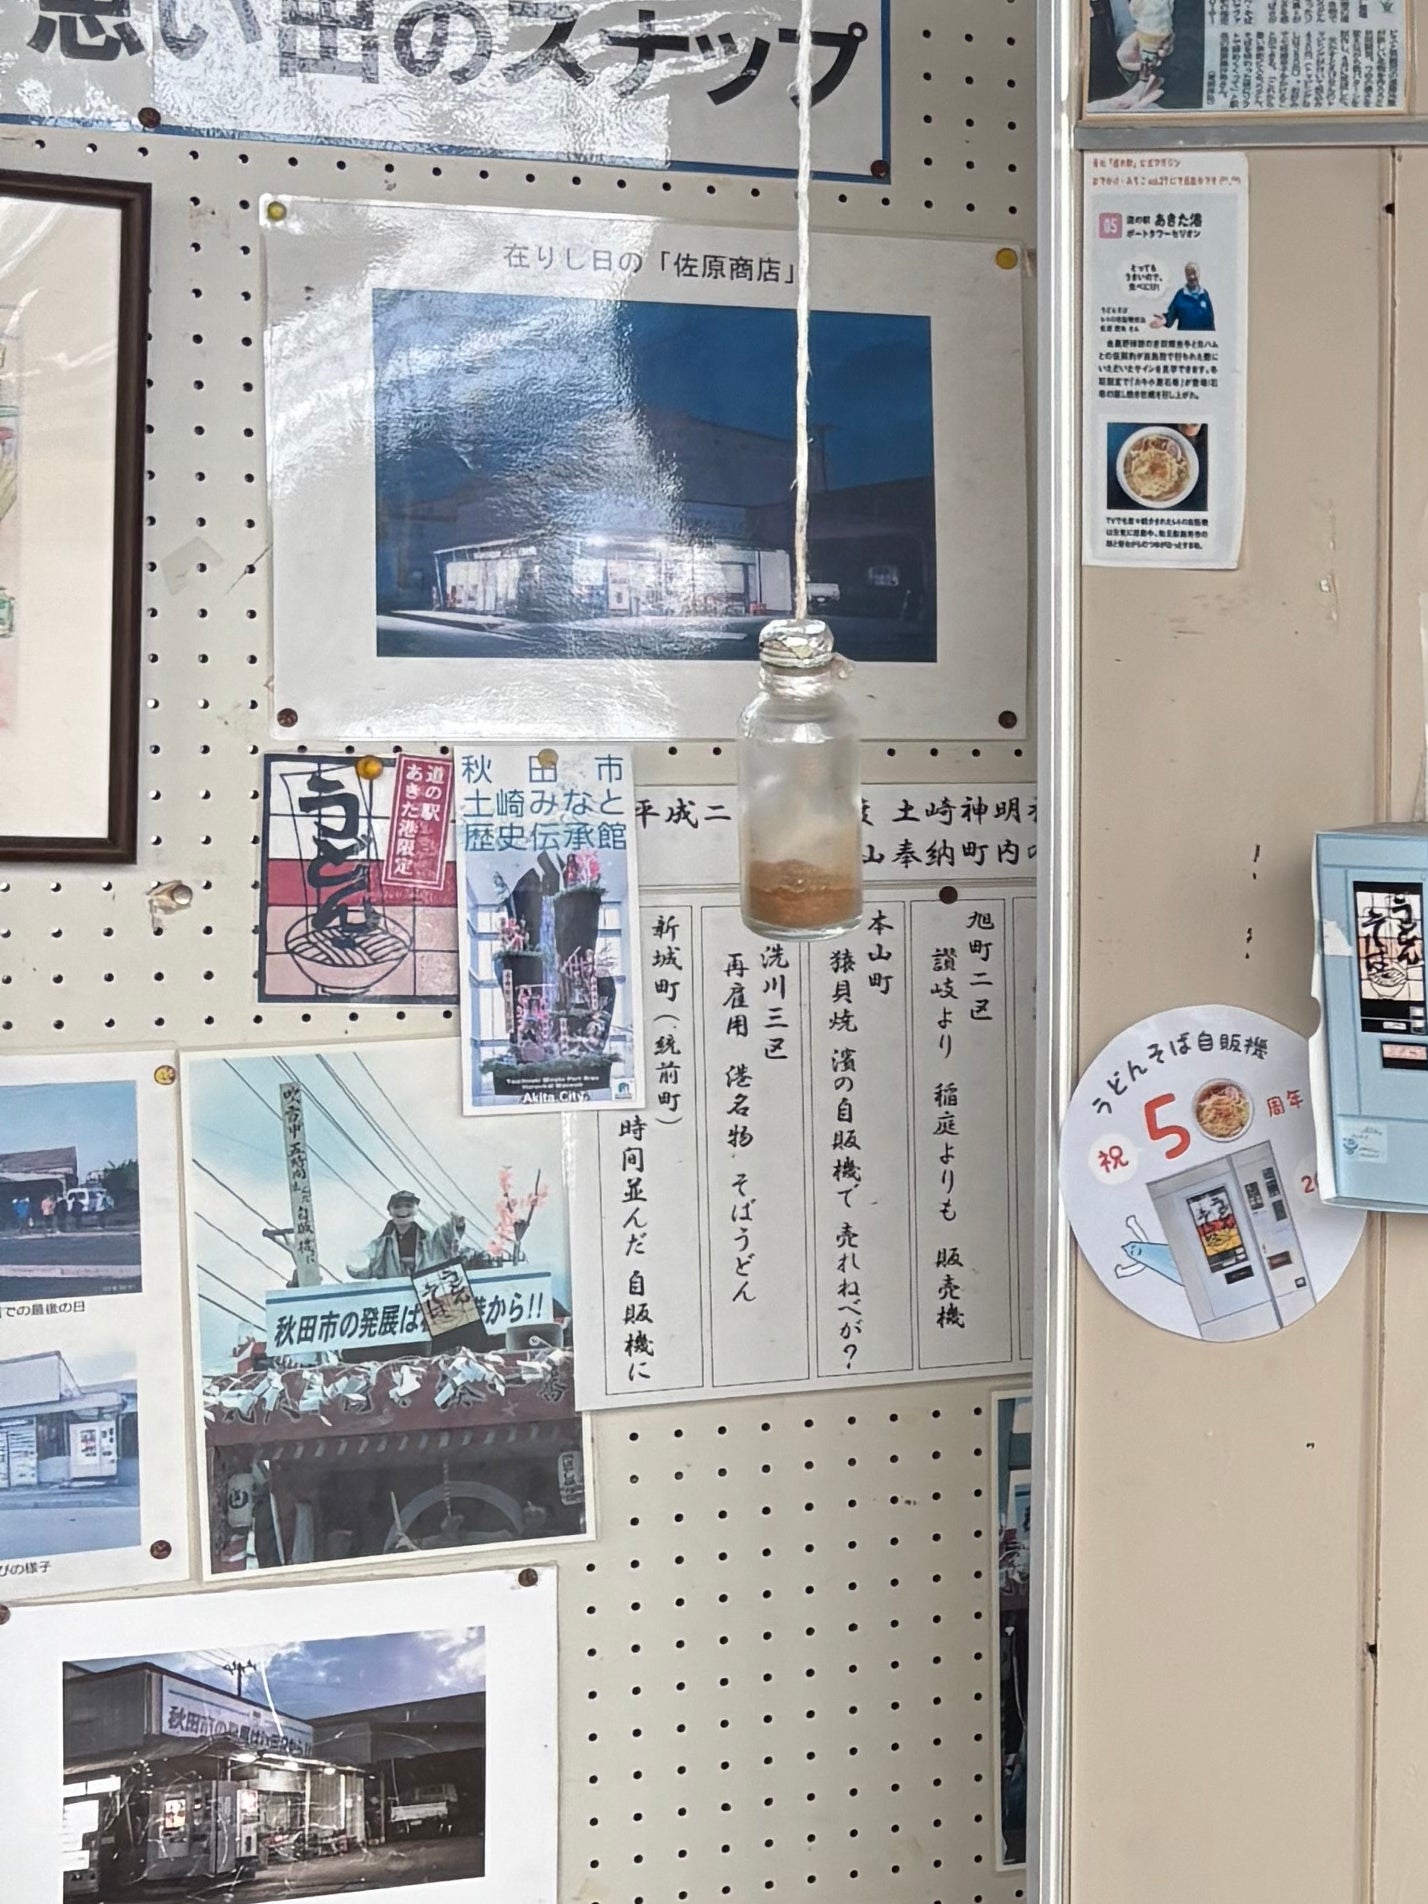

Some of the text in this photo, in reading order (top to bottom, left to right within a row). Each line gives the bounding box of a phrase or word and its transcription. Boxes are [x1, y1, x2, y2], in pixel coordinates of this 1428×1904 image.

[503, 243, 796, 285] 在りし日の「佐原商店」
[462, 753, 623, 784] 秋田市
[395, 764, 424, 876] あきた港限定
[463, 788, 623, 817] 土崎みなと
[299, 773, 382, 935] うどん
[464, 822, 626, 852] 歴史伝承館
[868, 911, 894, 994] 本山町
[967, 911, 993, 1021] 旭町二区
[523, 1091, 555, 1103] Akita
[1093, 1032, 1268, 1116] うどんそば自販機
[1266, 1089, 1303, 1117] 周年
[1098, 1144, 1129, 1173] 祝
[731, 1176, 755, 1302] そばうどん
[0, 1300, 85, 1318] での最後の日
[936, 1249, 964, 1329] 販売機
[625, 1273, 653, 1381] 自販機に
